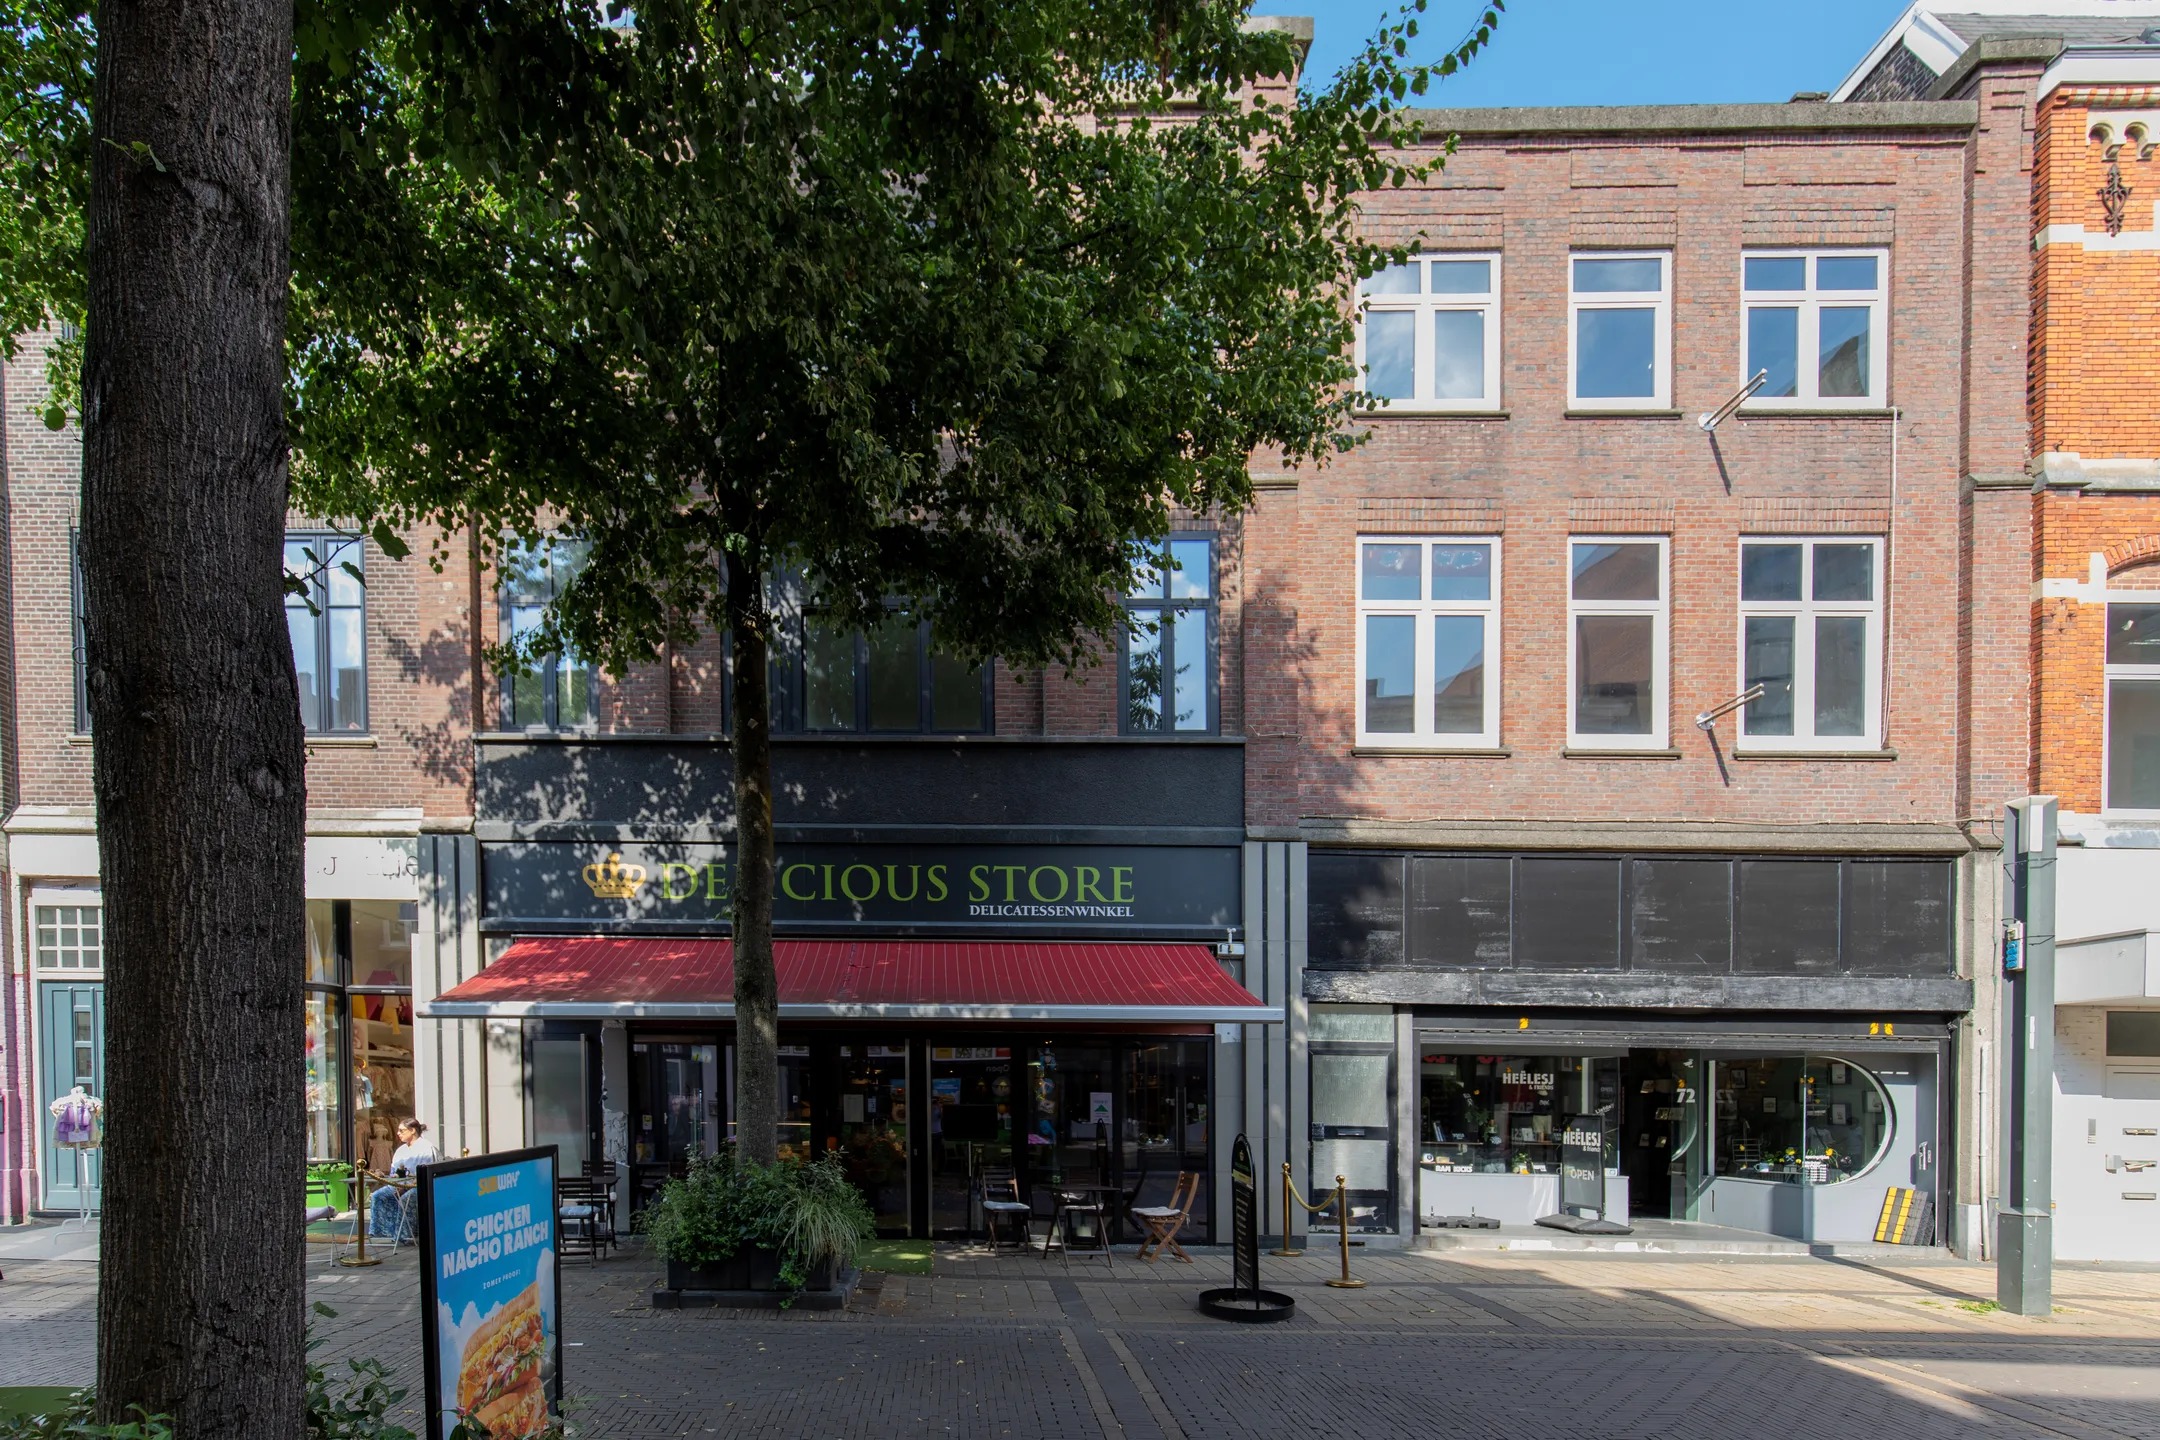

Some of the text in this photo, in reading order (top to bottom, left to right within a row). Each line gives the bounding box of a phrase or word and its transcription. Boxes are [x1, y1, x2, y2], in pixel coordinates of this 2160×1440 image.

[659, 863, 1135, 903] DECIOUS STORE
[969, 904, 1135, 917] DELICATESSENWINKEL
[1676, 1088, 1696, 1104] 72
[478, 1170, 520, 1197] SUBWAY
[1570, 1168, 1595, 1181] OPEN
[464, 1203, 531, 1243] CHICKEN
[442, 1219, 549, 1279] NACHO RANCH
